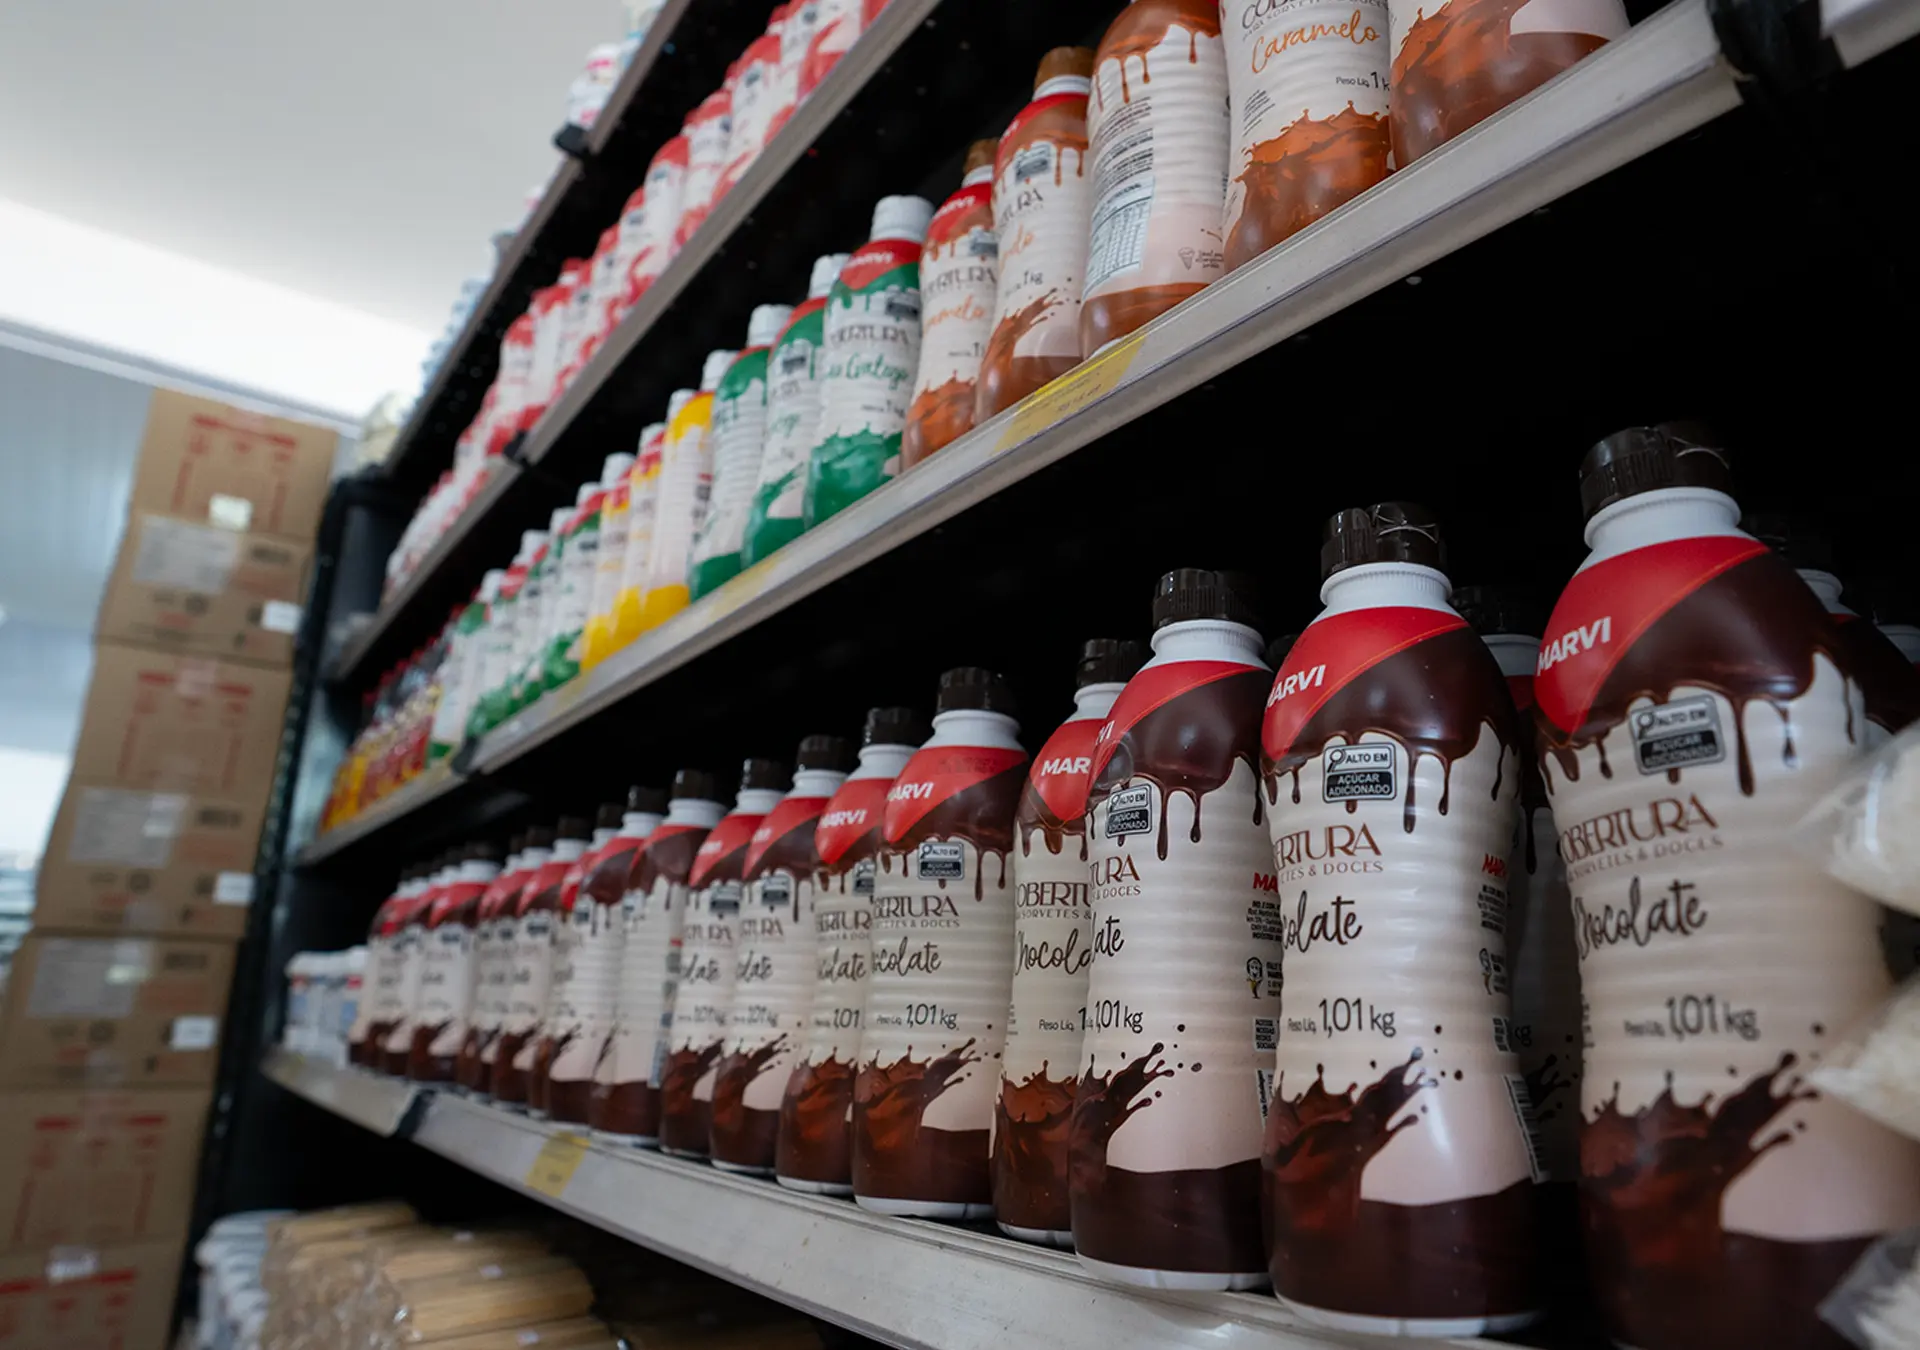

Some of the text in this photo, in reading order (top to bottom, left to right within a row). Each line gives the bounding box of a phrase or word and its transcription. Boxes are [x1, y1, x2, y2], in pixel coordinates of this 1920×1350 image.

[1251, 9, 1381, 73] Caramelo
[1537, 616, 1612, 677] MARVI
[1041, 757, 1091, 776] MAR
[1345, 752, 1388, 764] ALTO EM
[1328, 784, 1390, 797] ADICIONADO
[1308, 864, 1317, 877] &
[1323, 860, 1384, 876] DOCES
[1103, 885, 1142, 898] DOCES
[906, 1003, 938, 1028] 1,01
[1039, 1019, 1059, 1031] Peso
[1123, 1006, 1144, 1034] kg
[1319, 998, 1362, 1038] 1,01
[1370, 1004, 1397, 1038] kg
[1666, 994, 1719, 1042] 1,01
[1722, 1001, 1761, 1042] kg
